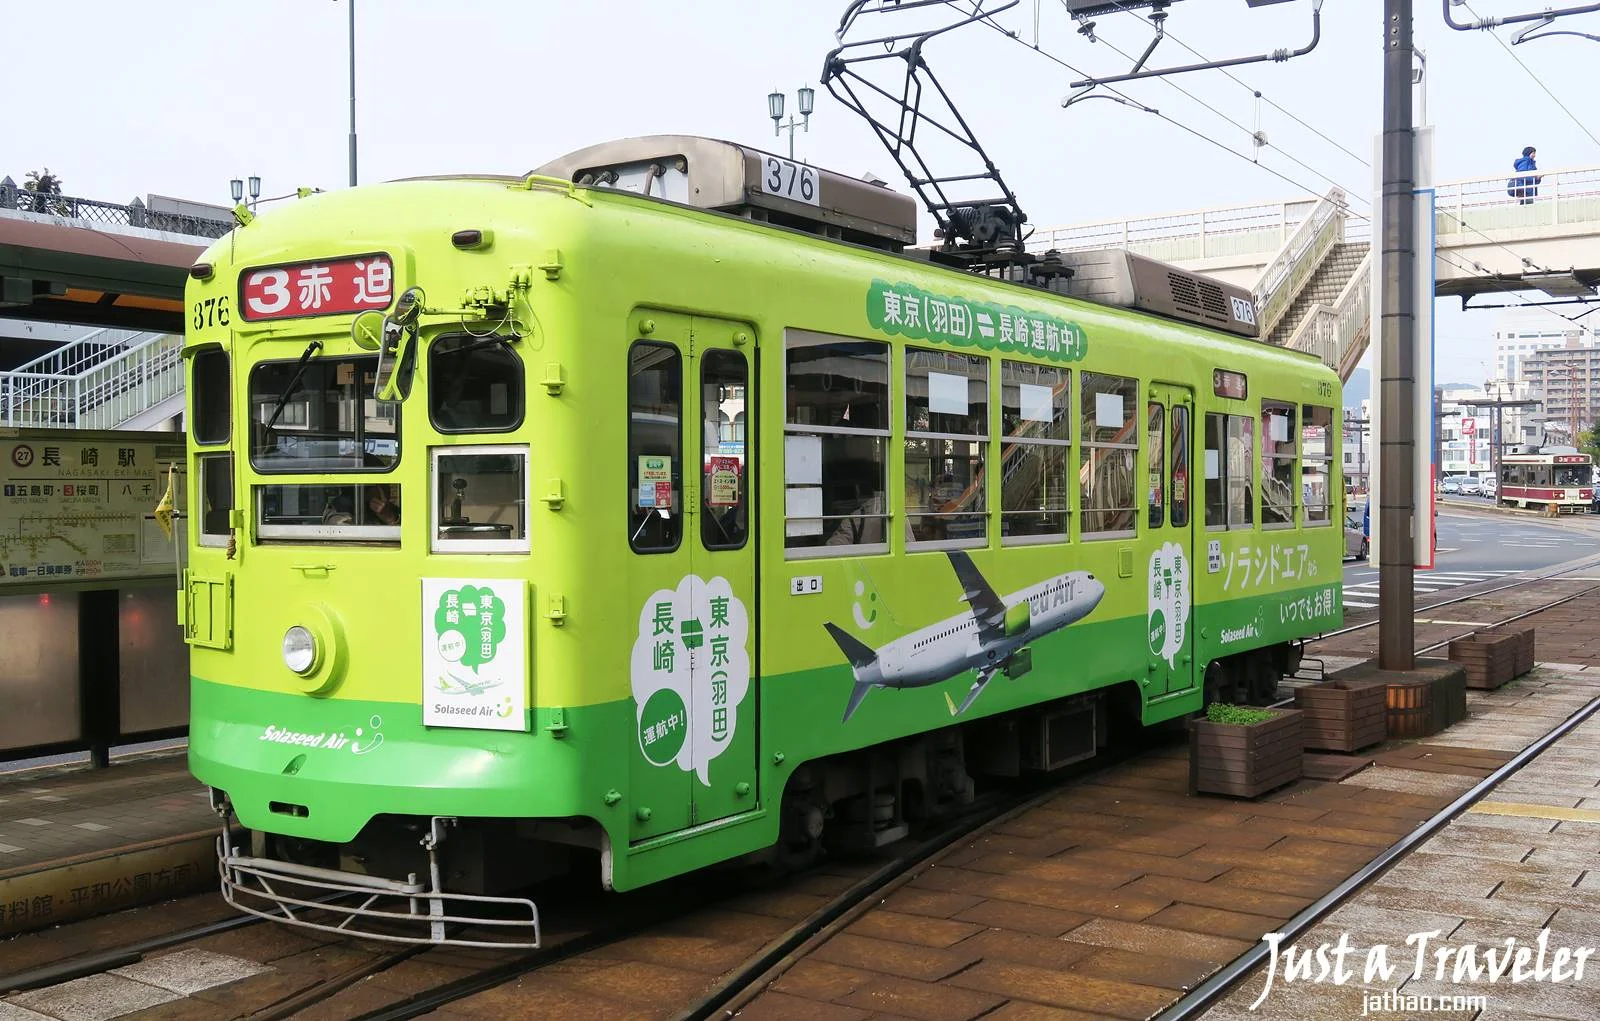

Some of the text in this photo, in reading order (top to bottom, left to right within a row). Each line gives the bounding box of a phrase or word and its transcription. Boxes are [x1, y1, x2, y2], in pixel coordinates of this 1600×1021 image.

[767, 157, 814, 201] 376
[248, 256, 392, 314] 3 赤迫
[882, 290, 1081, 357] 東京(羽田) 長崎運航中!
[1234, 298, 1254, 324] 376
[17, 446, 136, 468] 27 長崎駅
[796, 578, 818, 592] 出口
[1053, 575, 1076, 609] Air
[1153, 557, 1162, 601] 長崎
[446, 594, 460, 625] 長崎
[1280, 588, 1337, 624] いつでもお得!
[480, 594, 494, 659] 東京(羽田)
[652, 601, 675, 674] 長崎
[1220, 623, 1254, 644] Solaseed Air
[709, 595, 730, 743] 東京(羽田)
[434, 703, 494, 717] Solaseed Air
[260, 724, 350, 751] Solaseed Air
[643, 710, 685, 747] 運航中!
